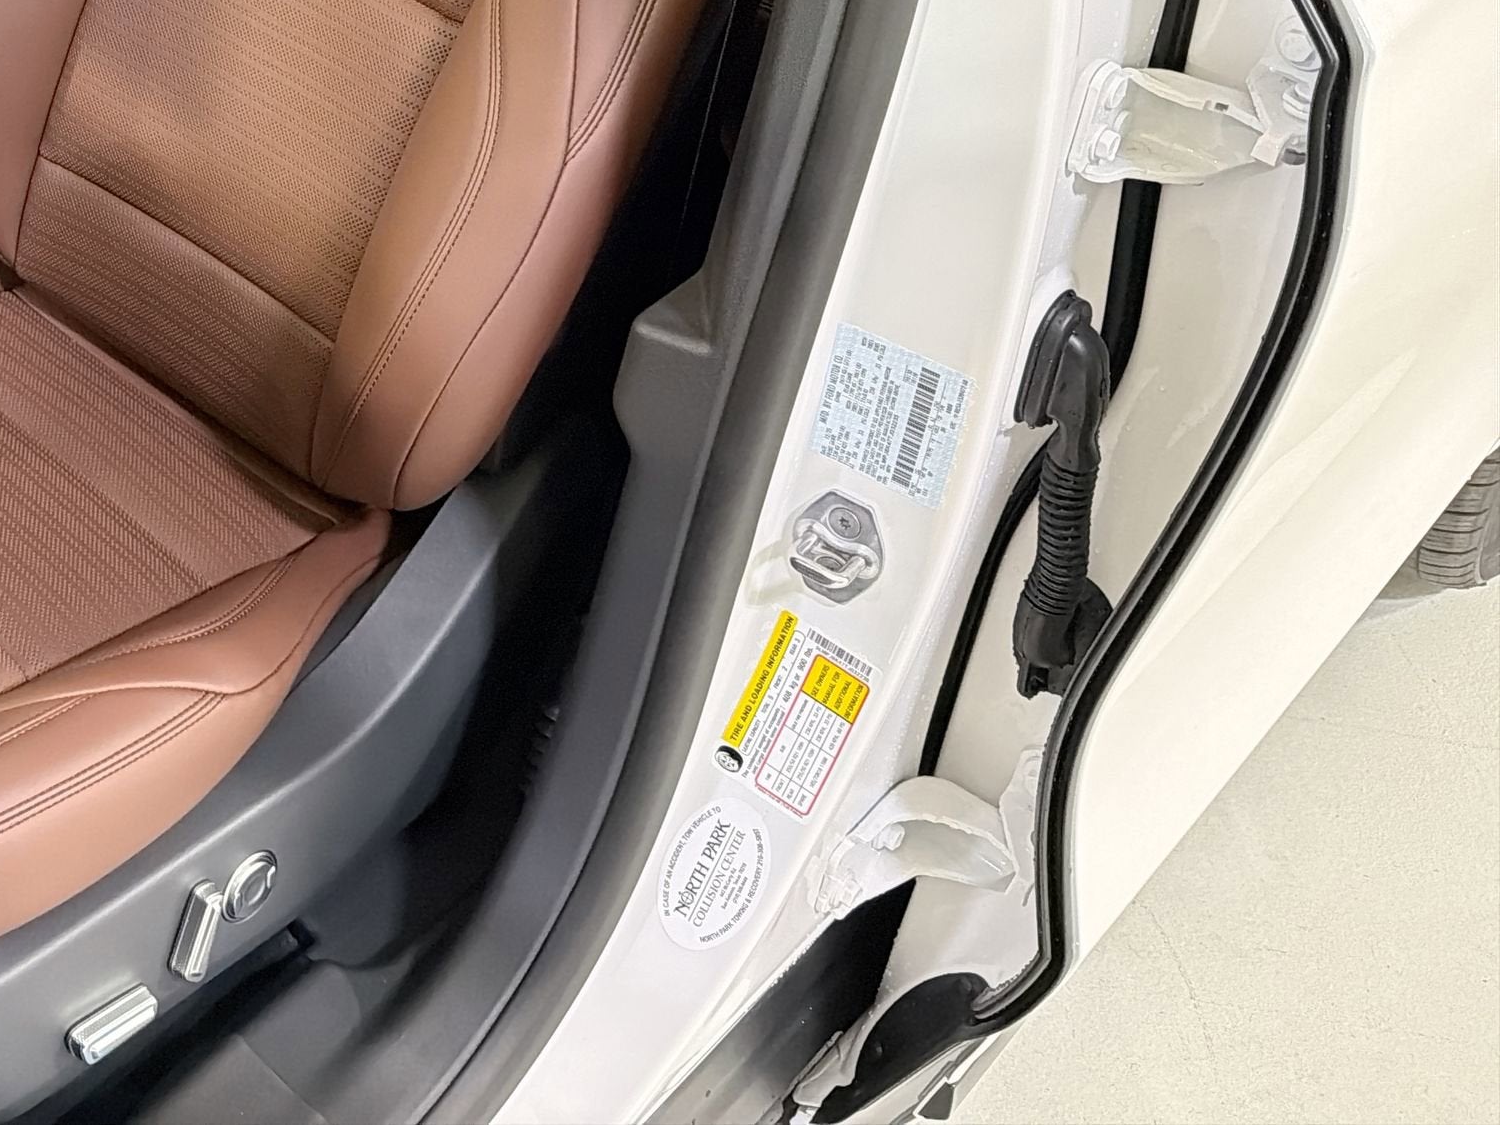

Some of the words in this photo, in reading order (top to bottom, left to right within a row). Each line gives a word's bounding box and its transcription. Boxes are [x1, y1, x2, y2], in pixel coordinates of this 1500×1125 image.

[830, 364, 840, 385] MOTOR
[822, 400, 832, 409] BY
[825, 384, 836, 400] FORD
[730, 722, 744, 740] TIRE
[740, 705, 752, 722] AND
[749, 670, 770, 704] LOADING
[766, 616, 794, 669] INFORMATION
[782, 690, 792, 703] 408
[789, 681, 798, 689] kg
[794, 673, 800, 681] or
[797, 658, 807, 671] 900
[811, 686, 819, 697] SEE
[816, 664, 830, 686] OWNERS
[822, 683, 836, 704] MANUAL
[832, 671, 841, 683] FOR
[834, 681, 852, 710] ADDITIONAL
[844, 684, 864, 719] INFORMATION
[691, 810, 713, 829] VEHICLE
[711, 806, 721, 814] TO
[682, 827, 693, 840] TOW
[666, 870, 672, 879] AN
[674, 861, 709, 917] NORTH
[701, 819, 731, 861] PARK
[693, 870, 726, 927] COLLISION
[721, 831, 746, 871] CENTER
[664, 879, 670, 889] OF
[700, 931, 720, 942] NORTH
[719, 921, 734, 935] PARK
[731, 903, 749, 923] TOWING
[748, 866, 762, 898] RECOVERY
